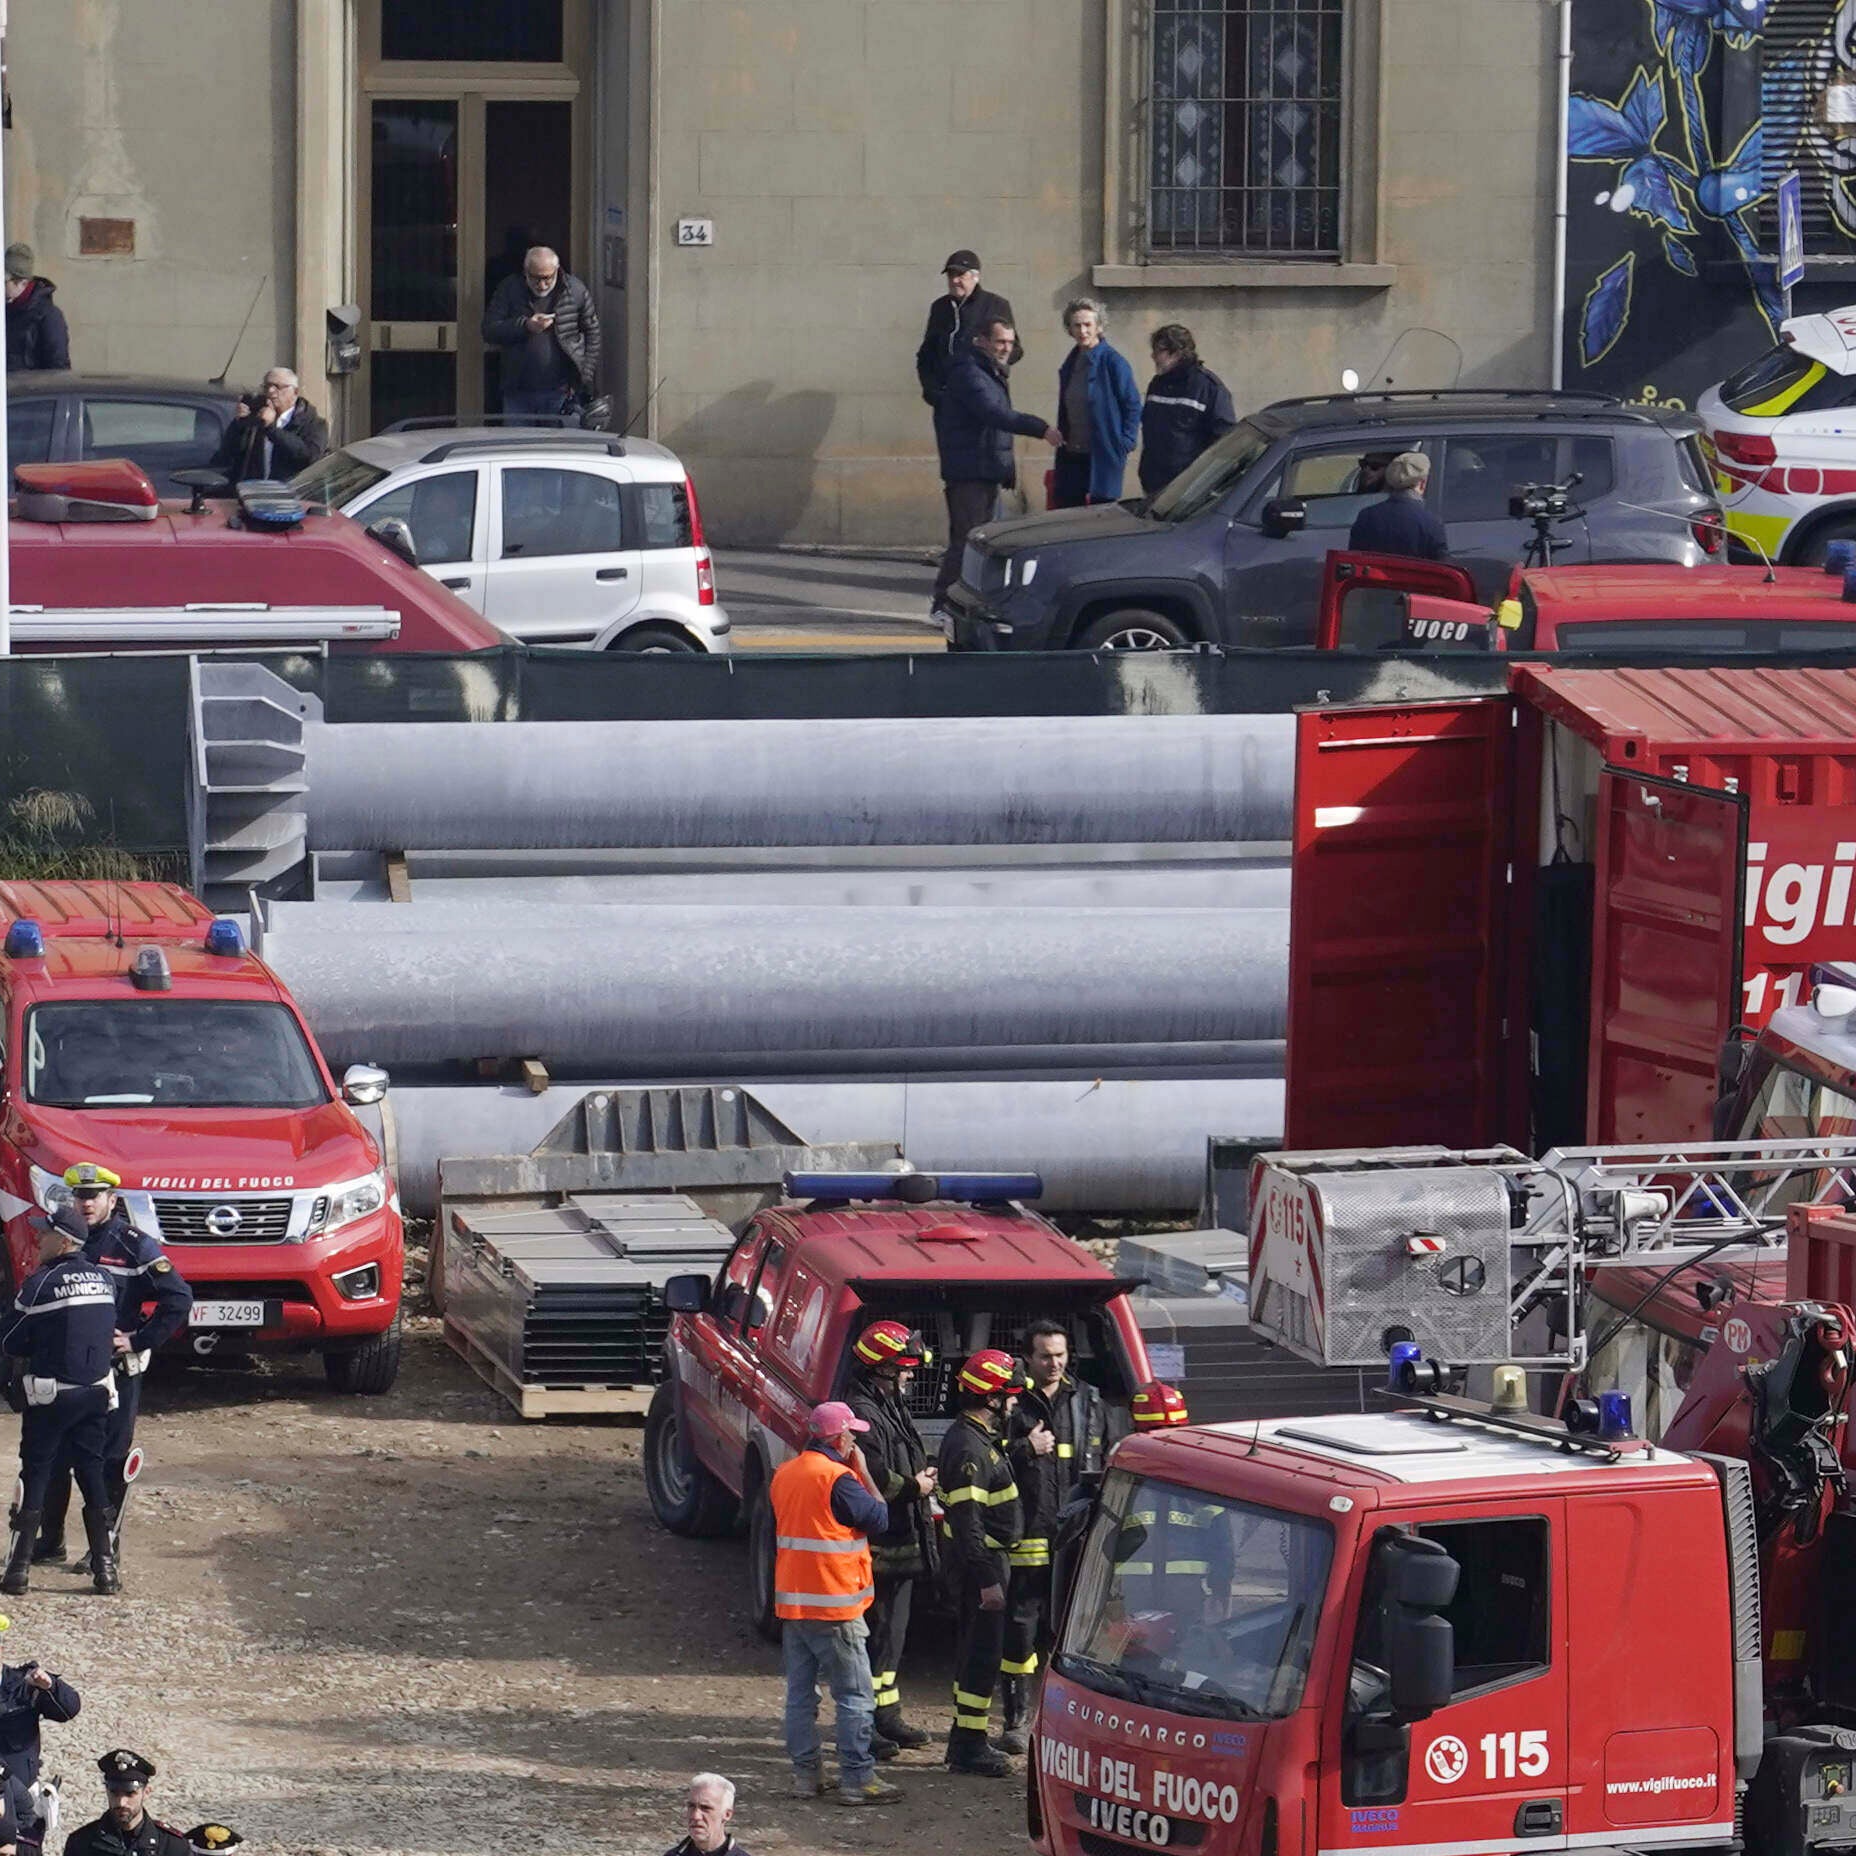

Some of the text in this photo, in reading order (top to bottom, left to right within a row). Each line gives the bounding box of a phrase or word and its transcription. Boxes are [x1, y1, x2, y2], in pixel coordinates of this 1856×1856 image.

[681, 225, 708, 241] 34
[1743, 972, 1805, 1014] 11
[141, 1175, 294, 1189] VIGILI DEL FUOCO
[1283, 1192, 1305, 1247] 115
[53, 1281, 114, 1299] MUNICIPA
[192, 1305, 261, 1322] VF 32499
[1727, 1323, 1749, 1346] PM
[1067, 1700, 1206, 1748] EUROCARGO
[1480, 1730, 1550, 1779] 115
[1040, 1735, 1239, 1824] VIGILI DEL FUOCO
[1606, 1773, 1717, 1795] www.vigilfuoco.it
[1090, 1797, 1170, 1847] IVECO
[1351, 1810, 1399, 1823] IVECO
